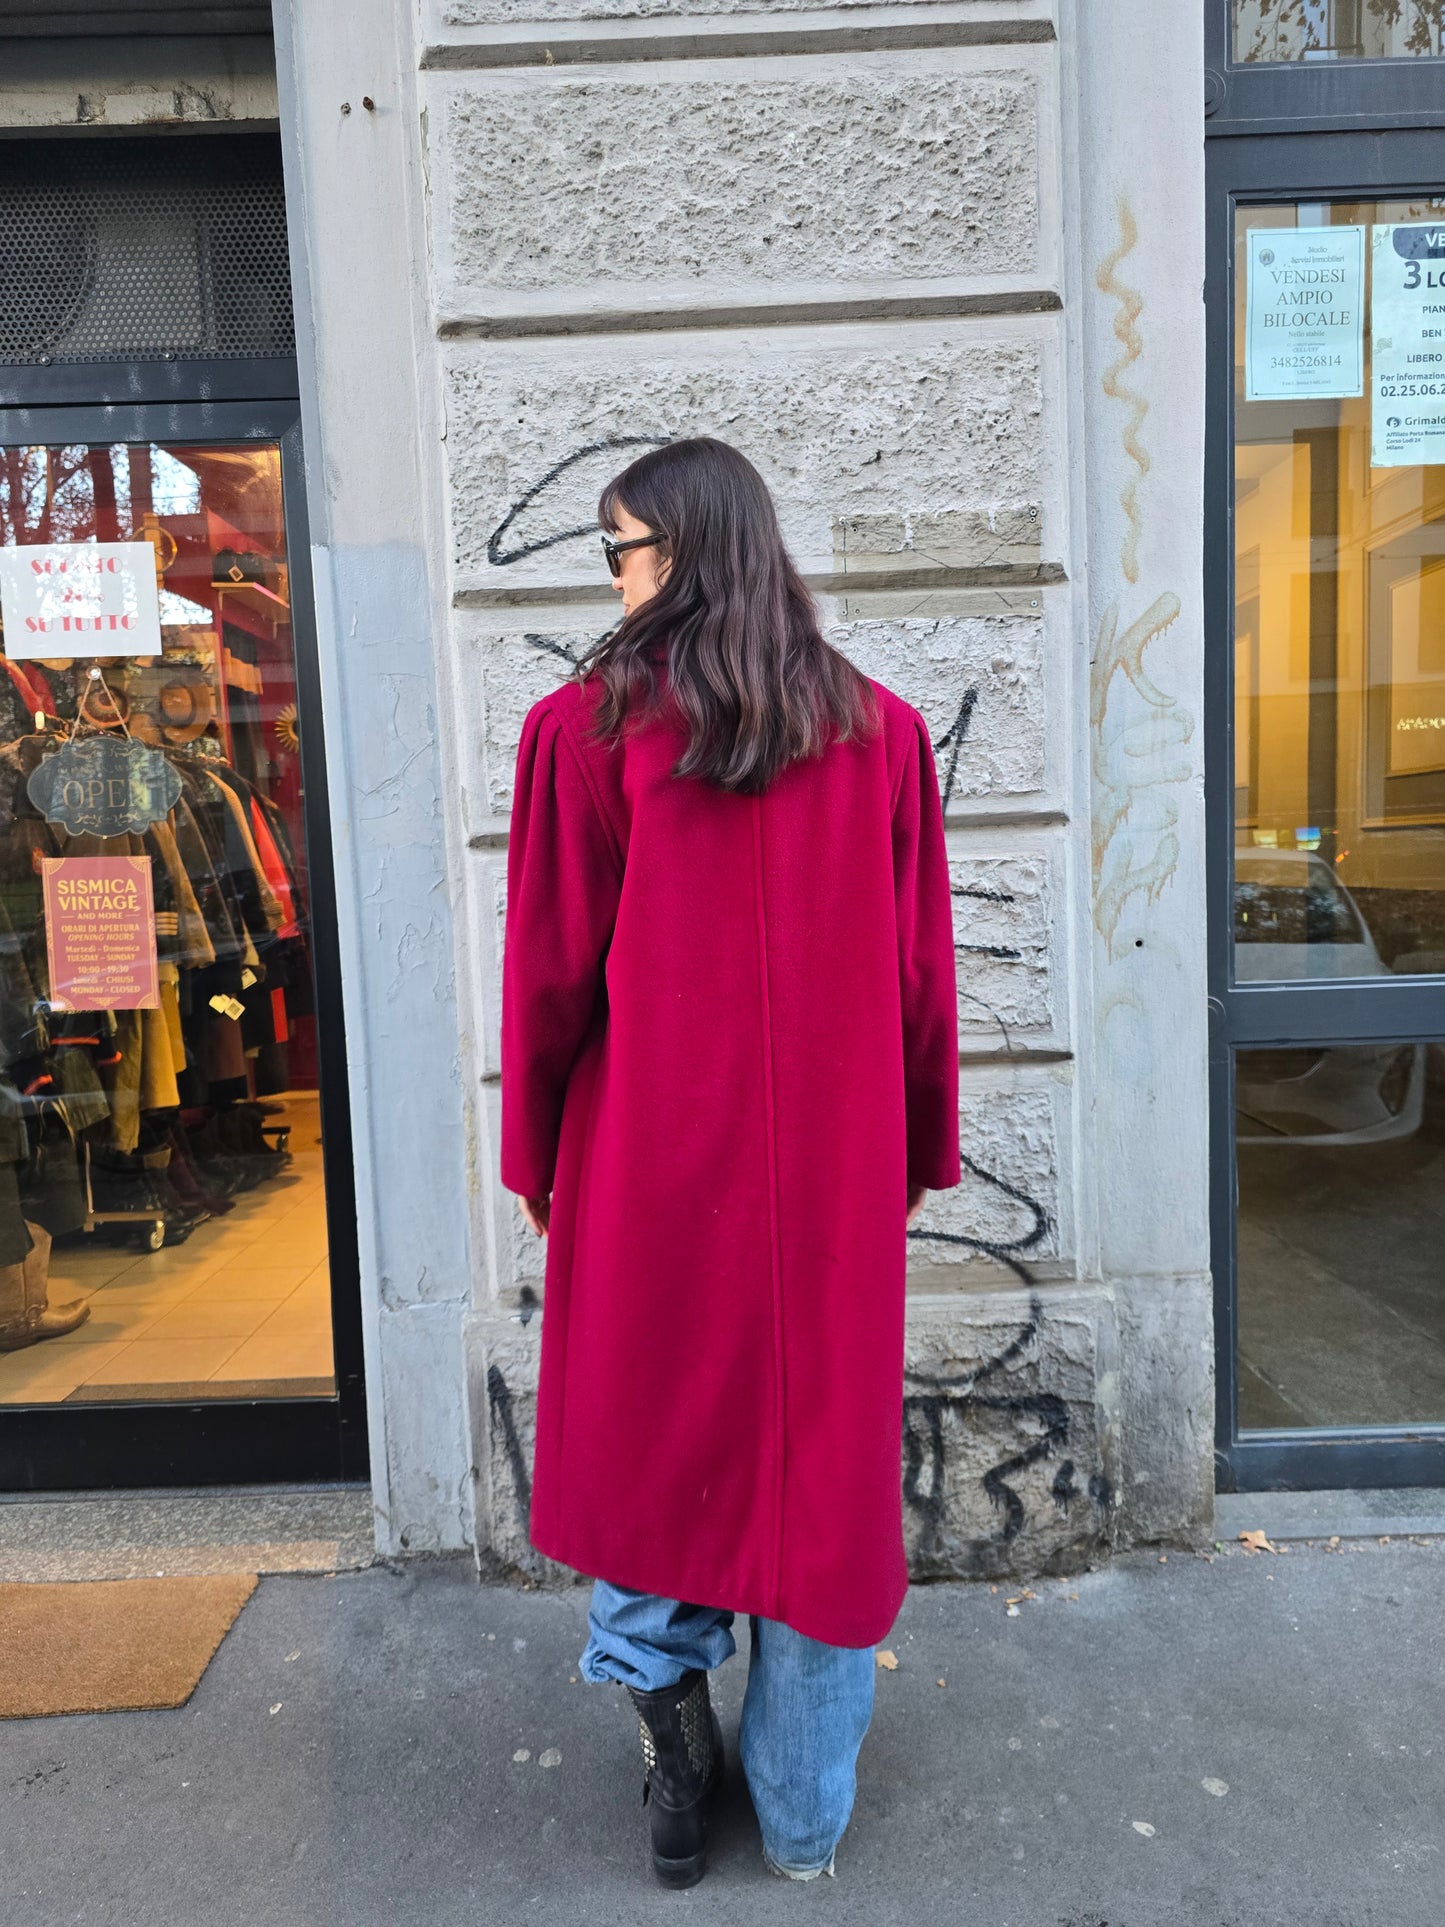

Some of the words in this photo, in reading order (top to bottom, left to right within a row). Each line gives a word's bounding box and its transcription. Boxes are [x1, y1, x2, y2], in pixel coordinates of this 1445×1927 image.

[1271, 269, 1346, 284] VENDESI
[1403, 260, 1422, 290] 3
[1276, 290, 1333, 305] AMPIO
[1264, 311, 1351, 328] BILOCALE
[1422, 329, 1442, 338] BEN
[1271, 355, 1342, 368] 3482526814
[1406, 353, 1443, 363] LIBERO
[60, 614, 137, 632] TUTTO
[57, 879, 138, 895] SISMICA
[58, 895, 138, 911] VINTAGE
[77, 912, 96, 920] AND
[98, 912, 123, 920] MORE
[61, 925, 87, 933] ORARI
[88, 924, 97, 932] DI
[99, 923, 140, 932] APERTURA
[68, 933, 104, 942] OPENING
[106, 933, 135, 941] HOURS
[67, 954, 98, 962] TUESDAY
[106, 953, 136, 961] SUNDAY
[78, 966, 100, 974] 10:00
[106, 976, 134, 984] CHIUSI
[70, 986, 104, 994] MONDAY
[110, 985, 140, 993] CLOSED
